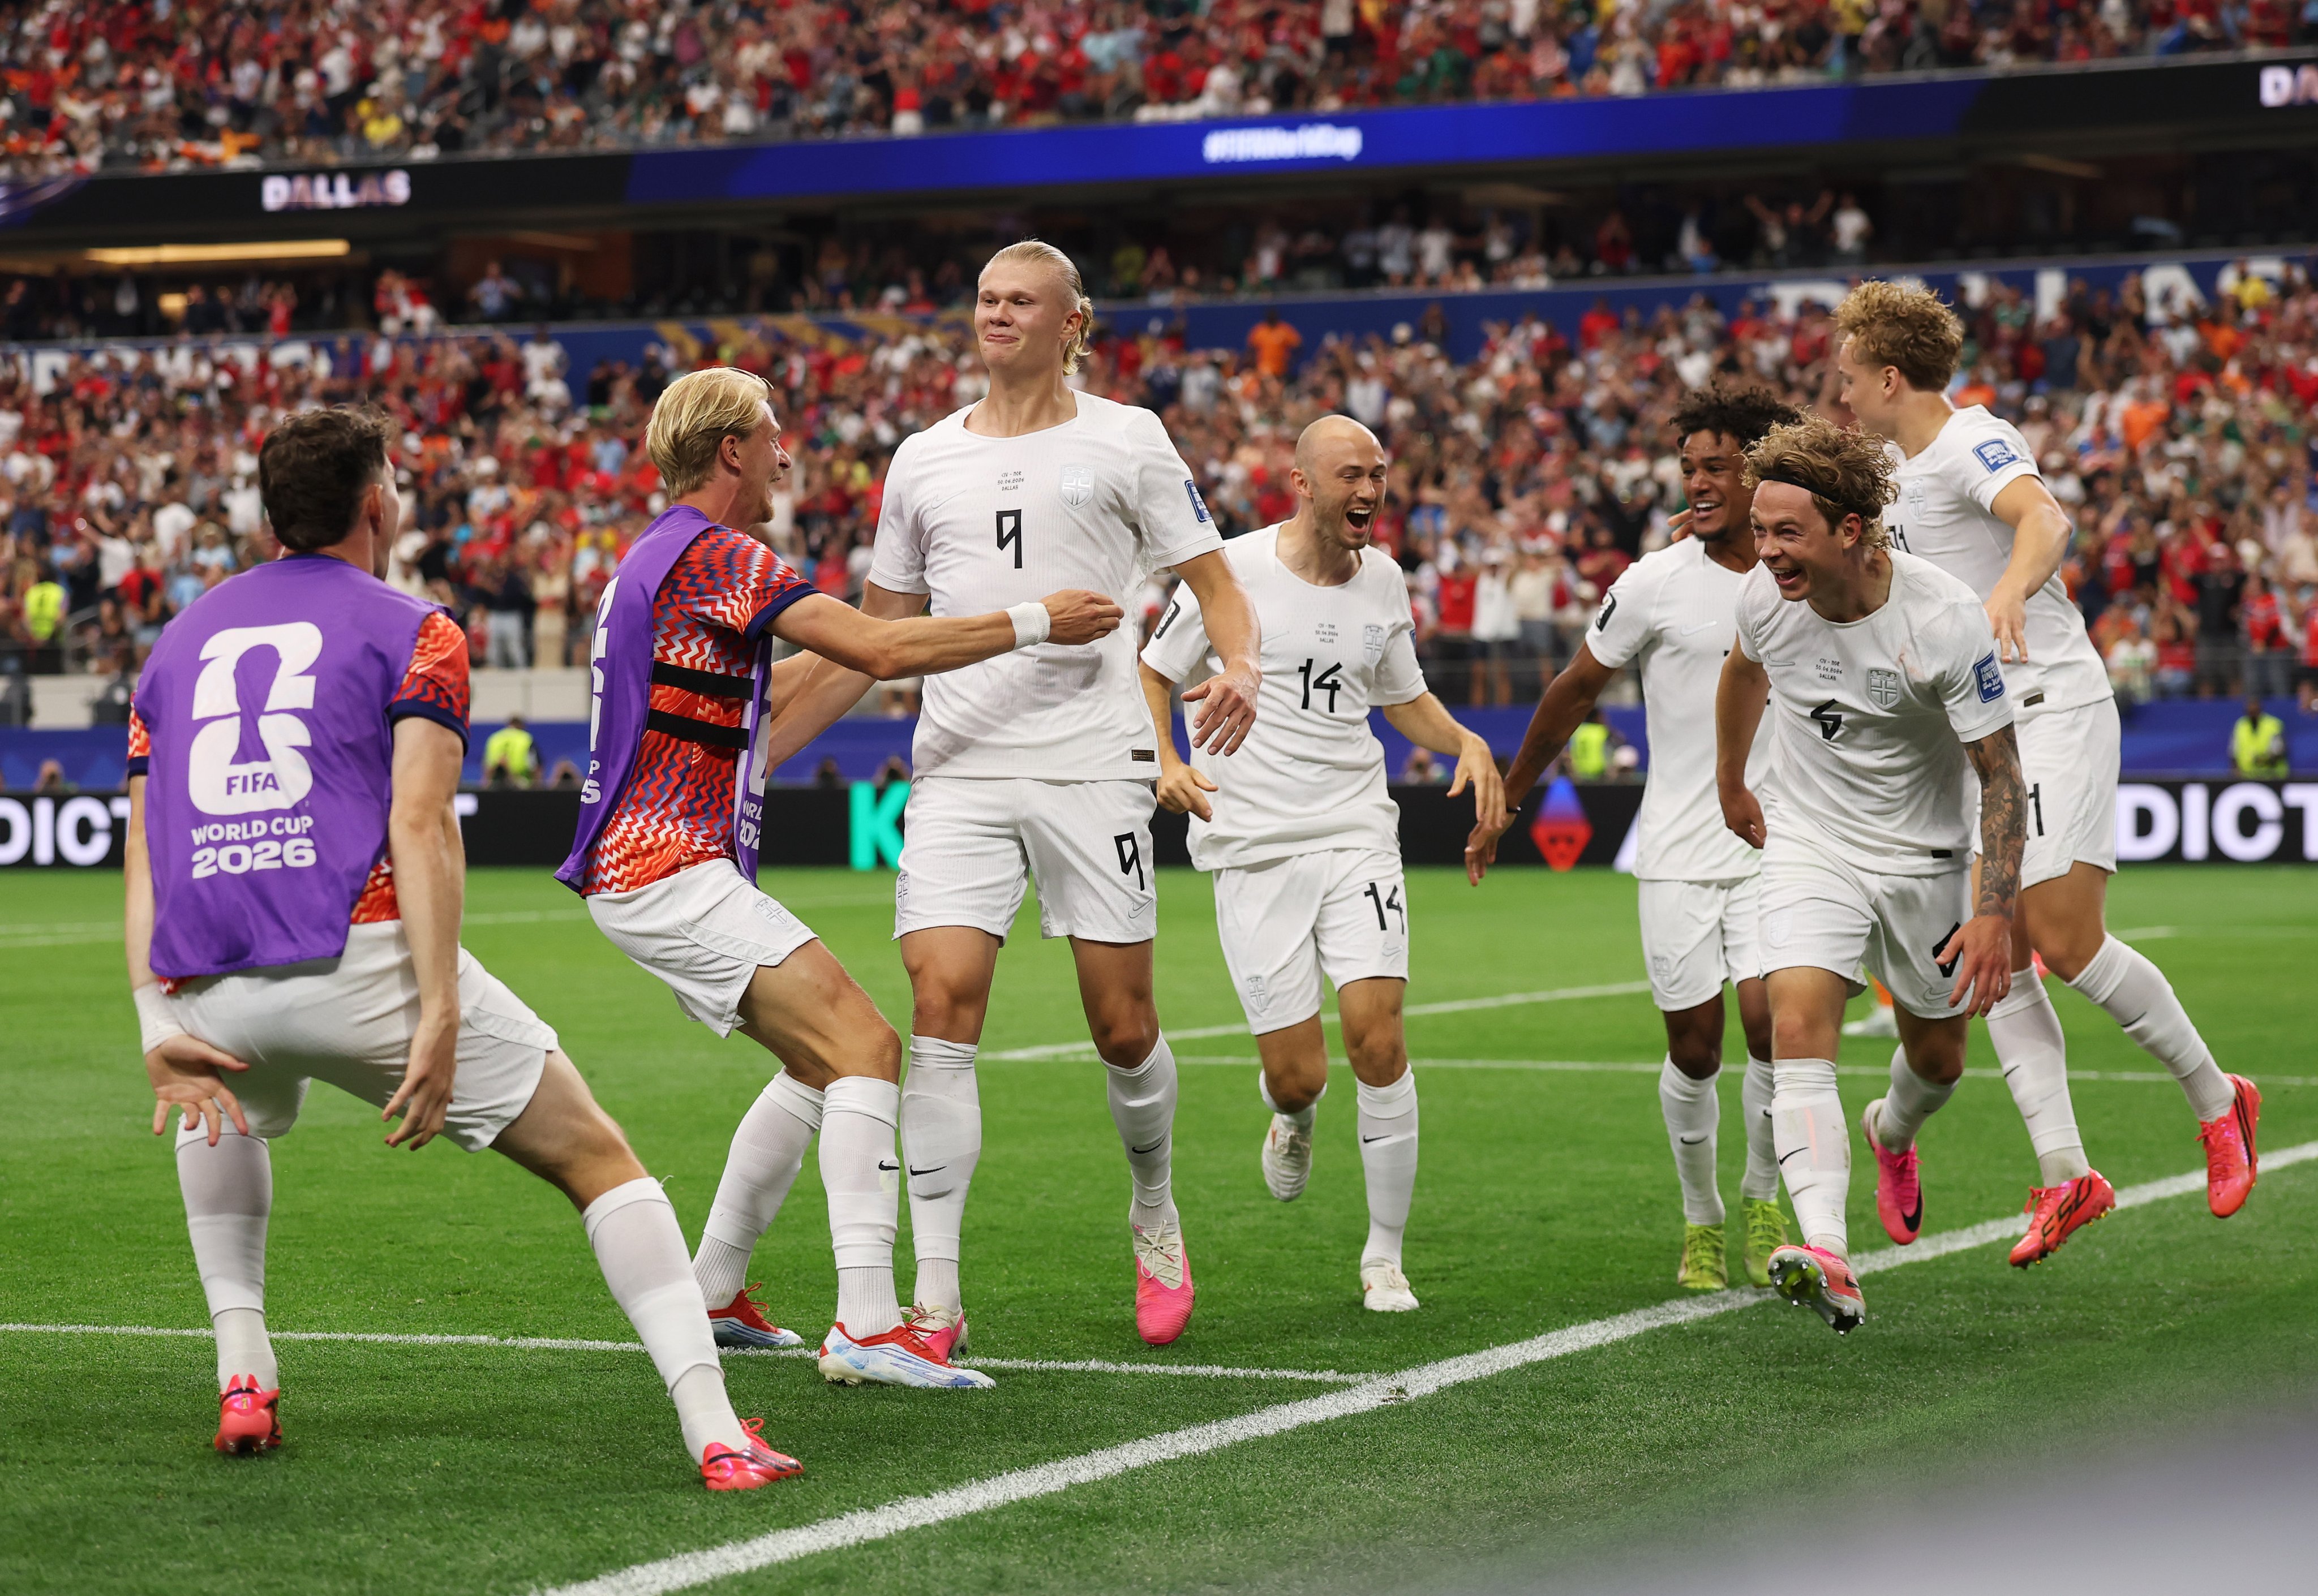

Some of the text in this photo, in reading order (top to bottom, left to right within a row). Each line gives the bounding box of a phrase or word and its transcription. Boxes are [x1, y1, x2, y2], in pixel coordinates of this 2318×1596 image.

[261, 169, 411, 212] DALLAS
[996, 509, 1023, 569] 9
[1298, 658, 1343, 713] 14
[226, 772, 280, 796] FIFA
[191, 815, 314, 846] WORLD CUP
[192, 837, 317, 879] 2026
[1114, 831, 1145, 891] 9
[1363, 882, 1405, 935] 14
